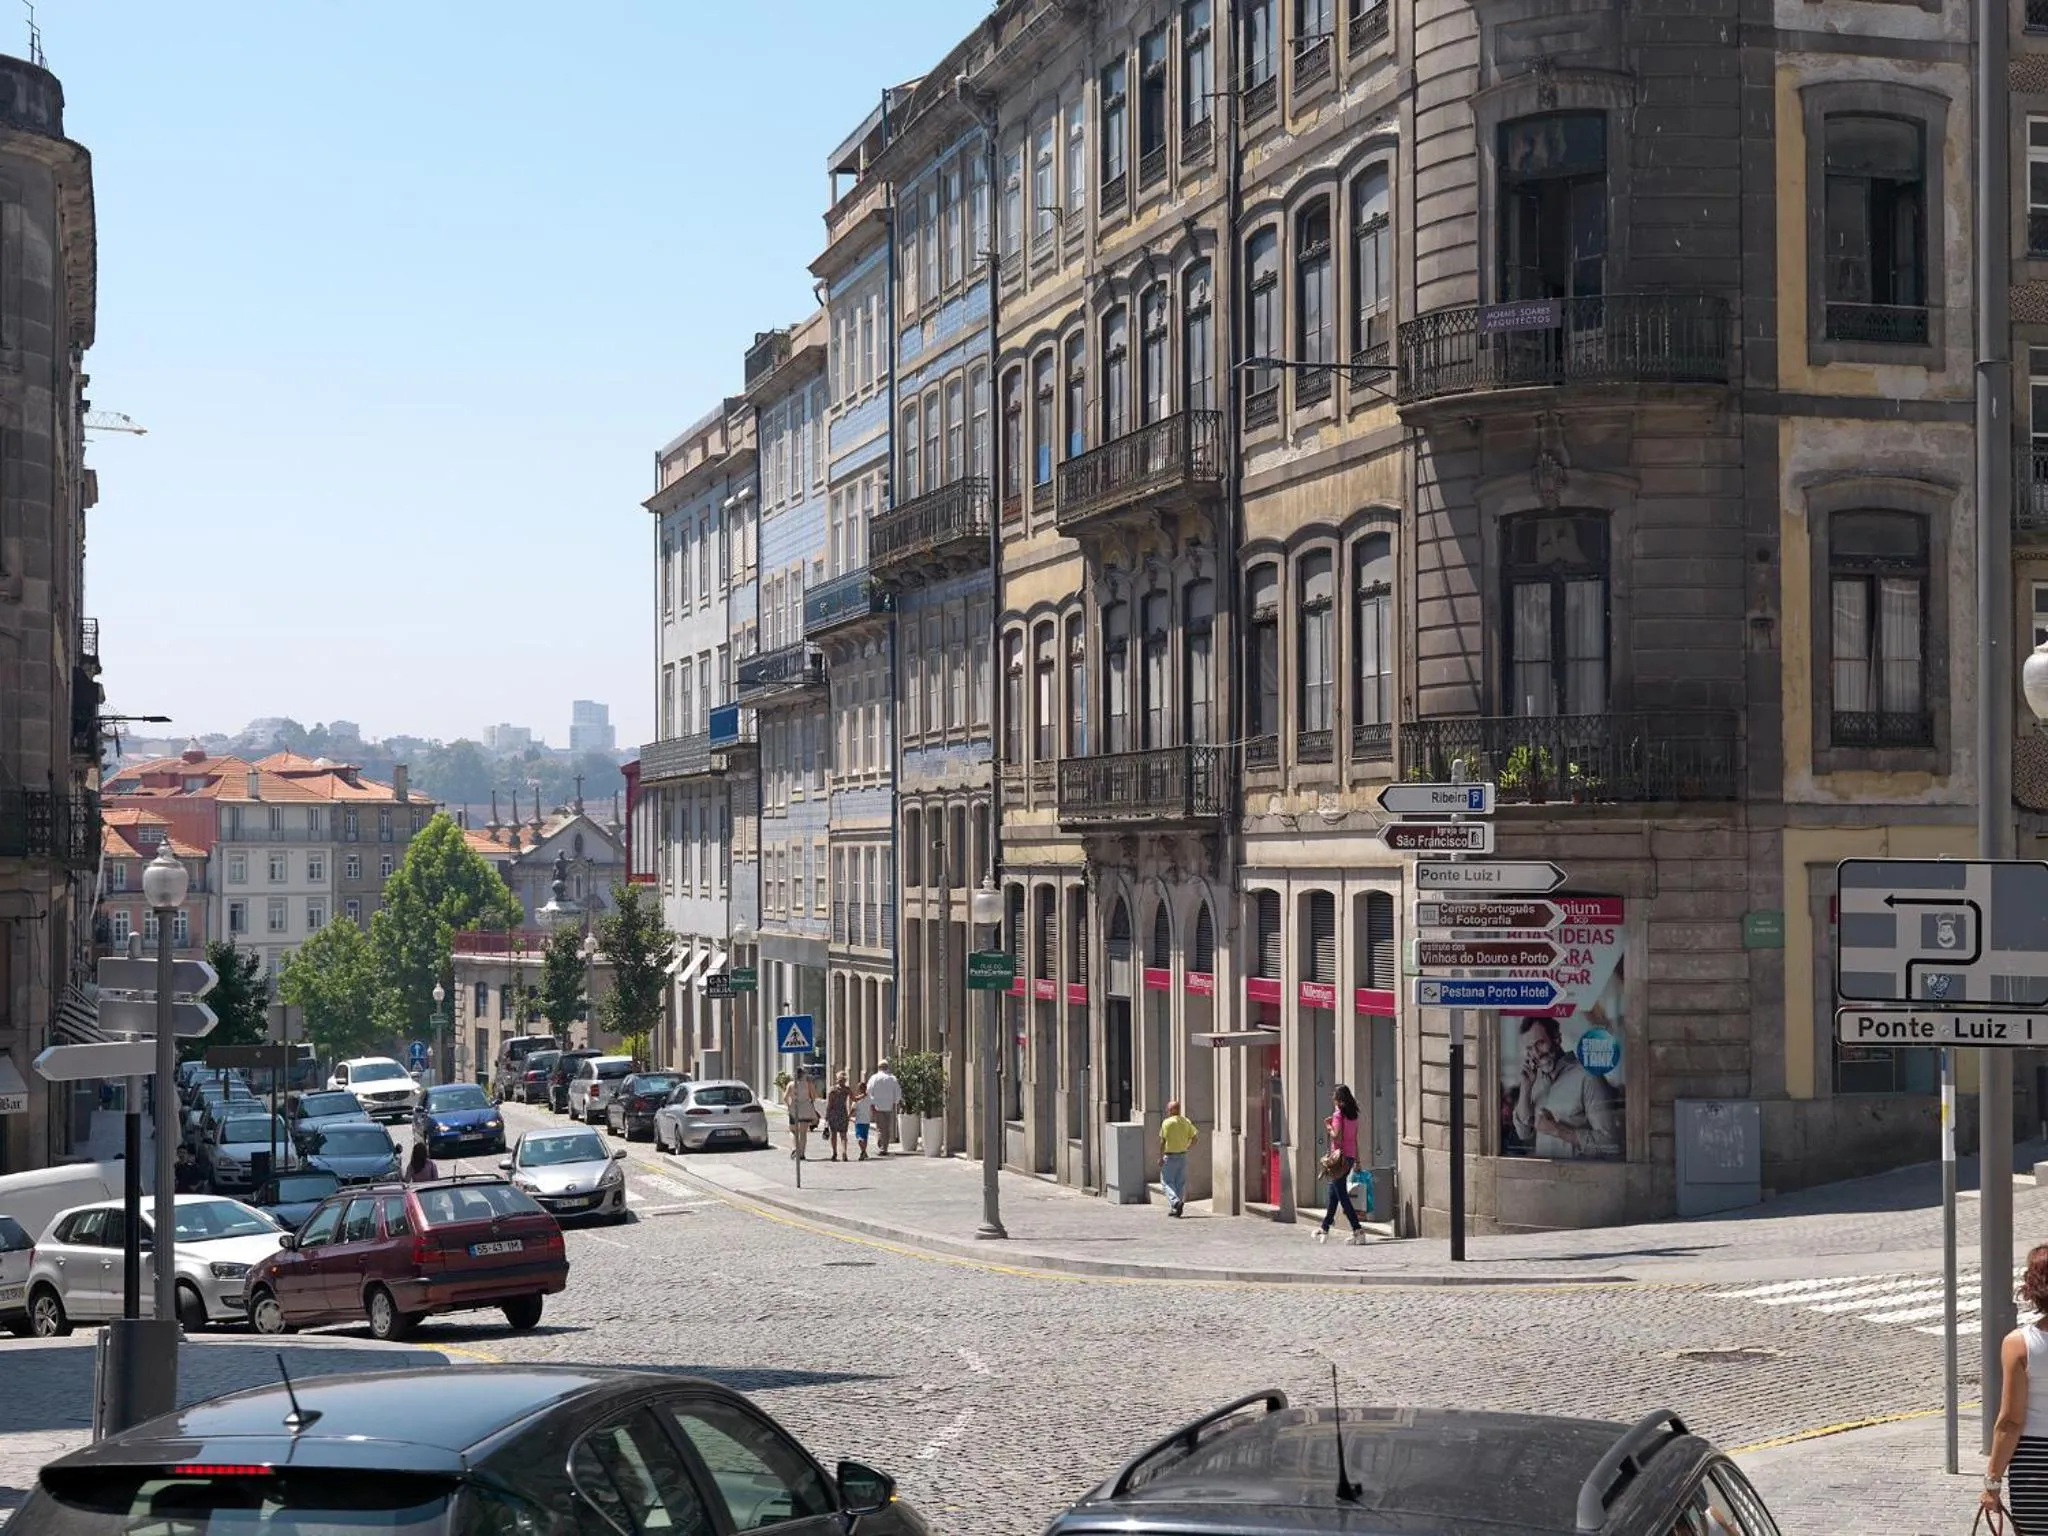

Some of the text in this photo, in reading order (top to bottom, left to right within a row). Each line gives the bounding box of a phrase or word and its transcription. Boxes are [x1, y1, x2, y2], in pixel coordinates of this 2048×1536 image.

[1520, 307, 1551, 316] SOARES
[1487, 316, 1550, 328] ARQUITECTOS
[1431, 791, 1467, 804] Ribeira
[1396, 833, 1467, 847] São Francisco
[1420, 869, 1460, 881] Ponte
[1464, 869, 1494, 881] Luiz
[1440, 903, 1536, 917] Centro Português
[1456, 914, 1512, 927] Fotografia
[1558, 928, 1615, 945] IDEIAS
[1421, 951, 1550, 964] Vinhos do Douro e Porto
[1441, 985, 1549, 998] Pestana Porto Hotel
[1858, 1016, 2033, 1040] Ponte Luiz I
